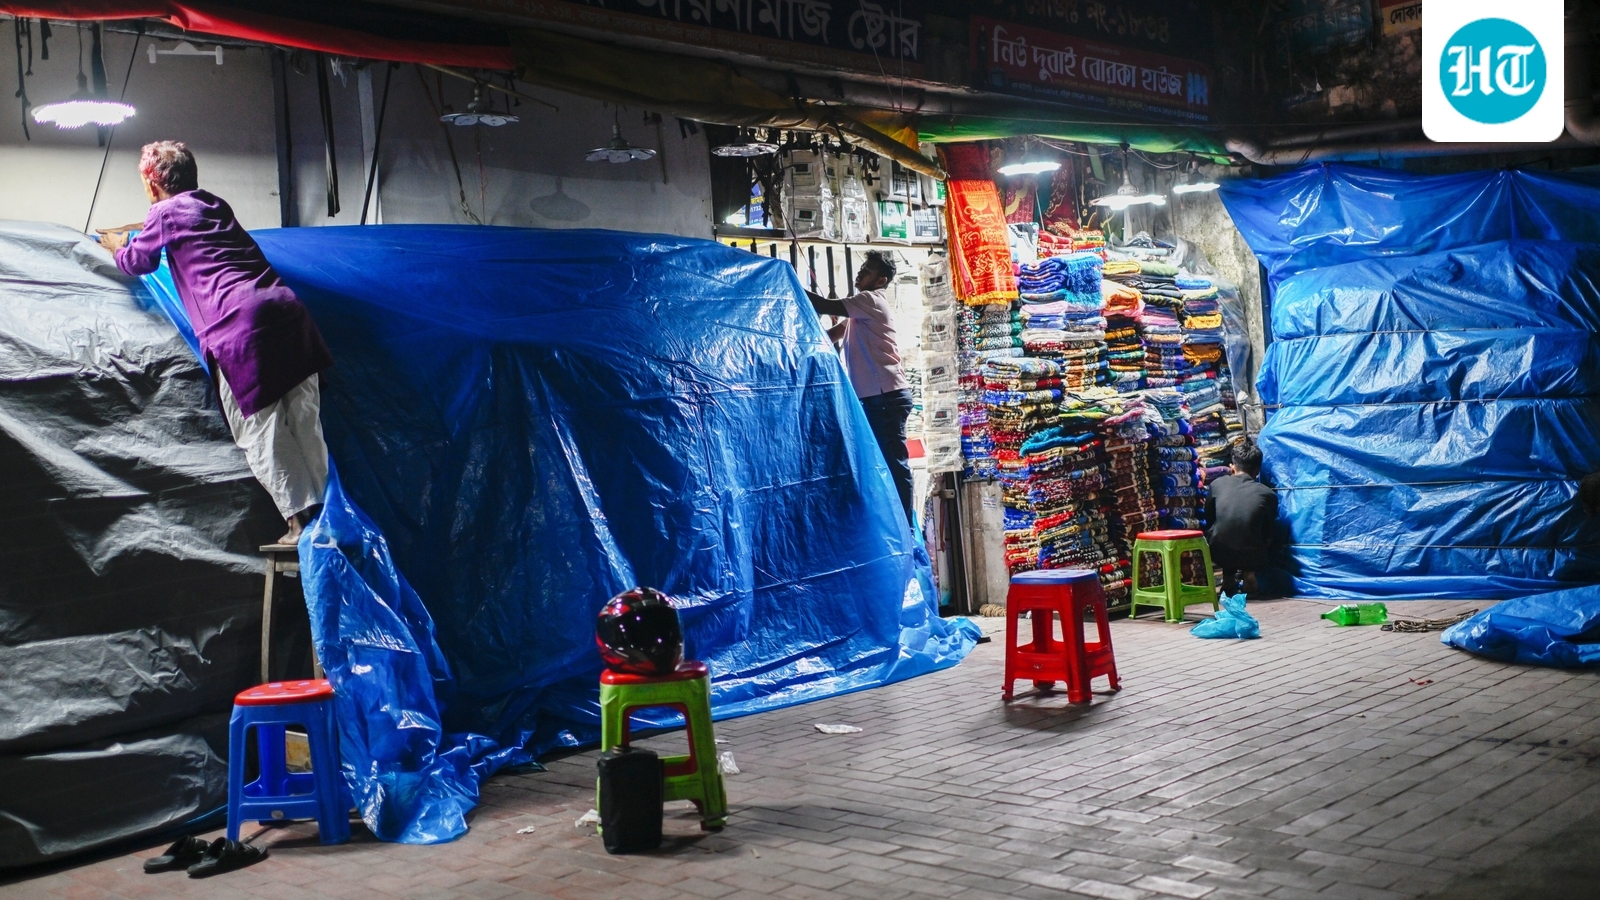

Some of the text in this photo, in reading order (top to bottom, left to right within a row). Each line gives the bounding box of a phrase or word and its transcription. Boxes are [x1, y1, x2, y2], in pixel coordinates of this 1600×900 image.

[992, 24, 1028, 68] নিউ
[1032, 46, 1077, 83] দুবাই
[1081, 56, 1137, 88] বোরকা
[1141, 65, 1184, 97] হাউজ
